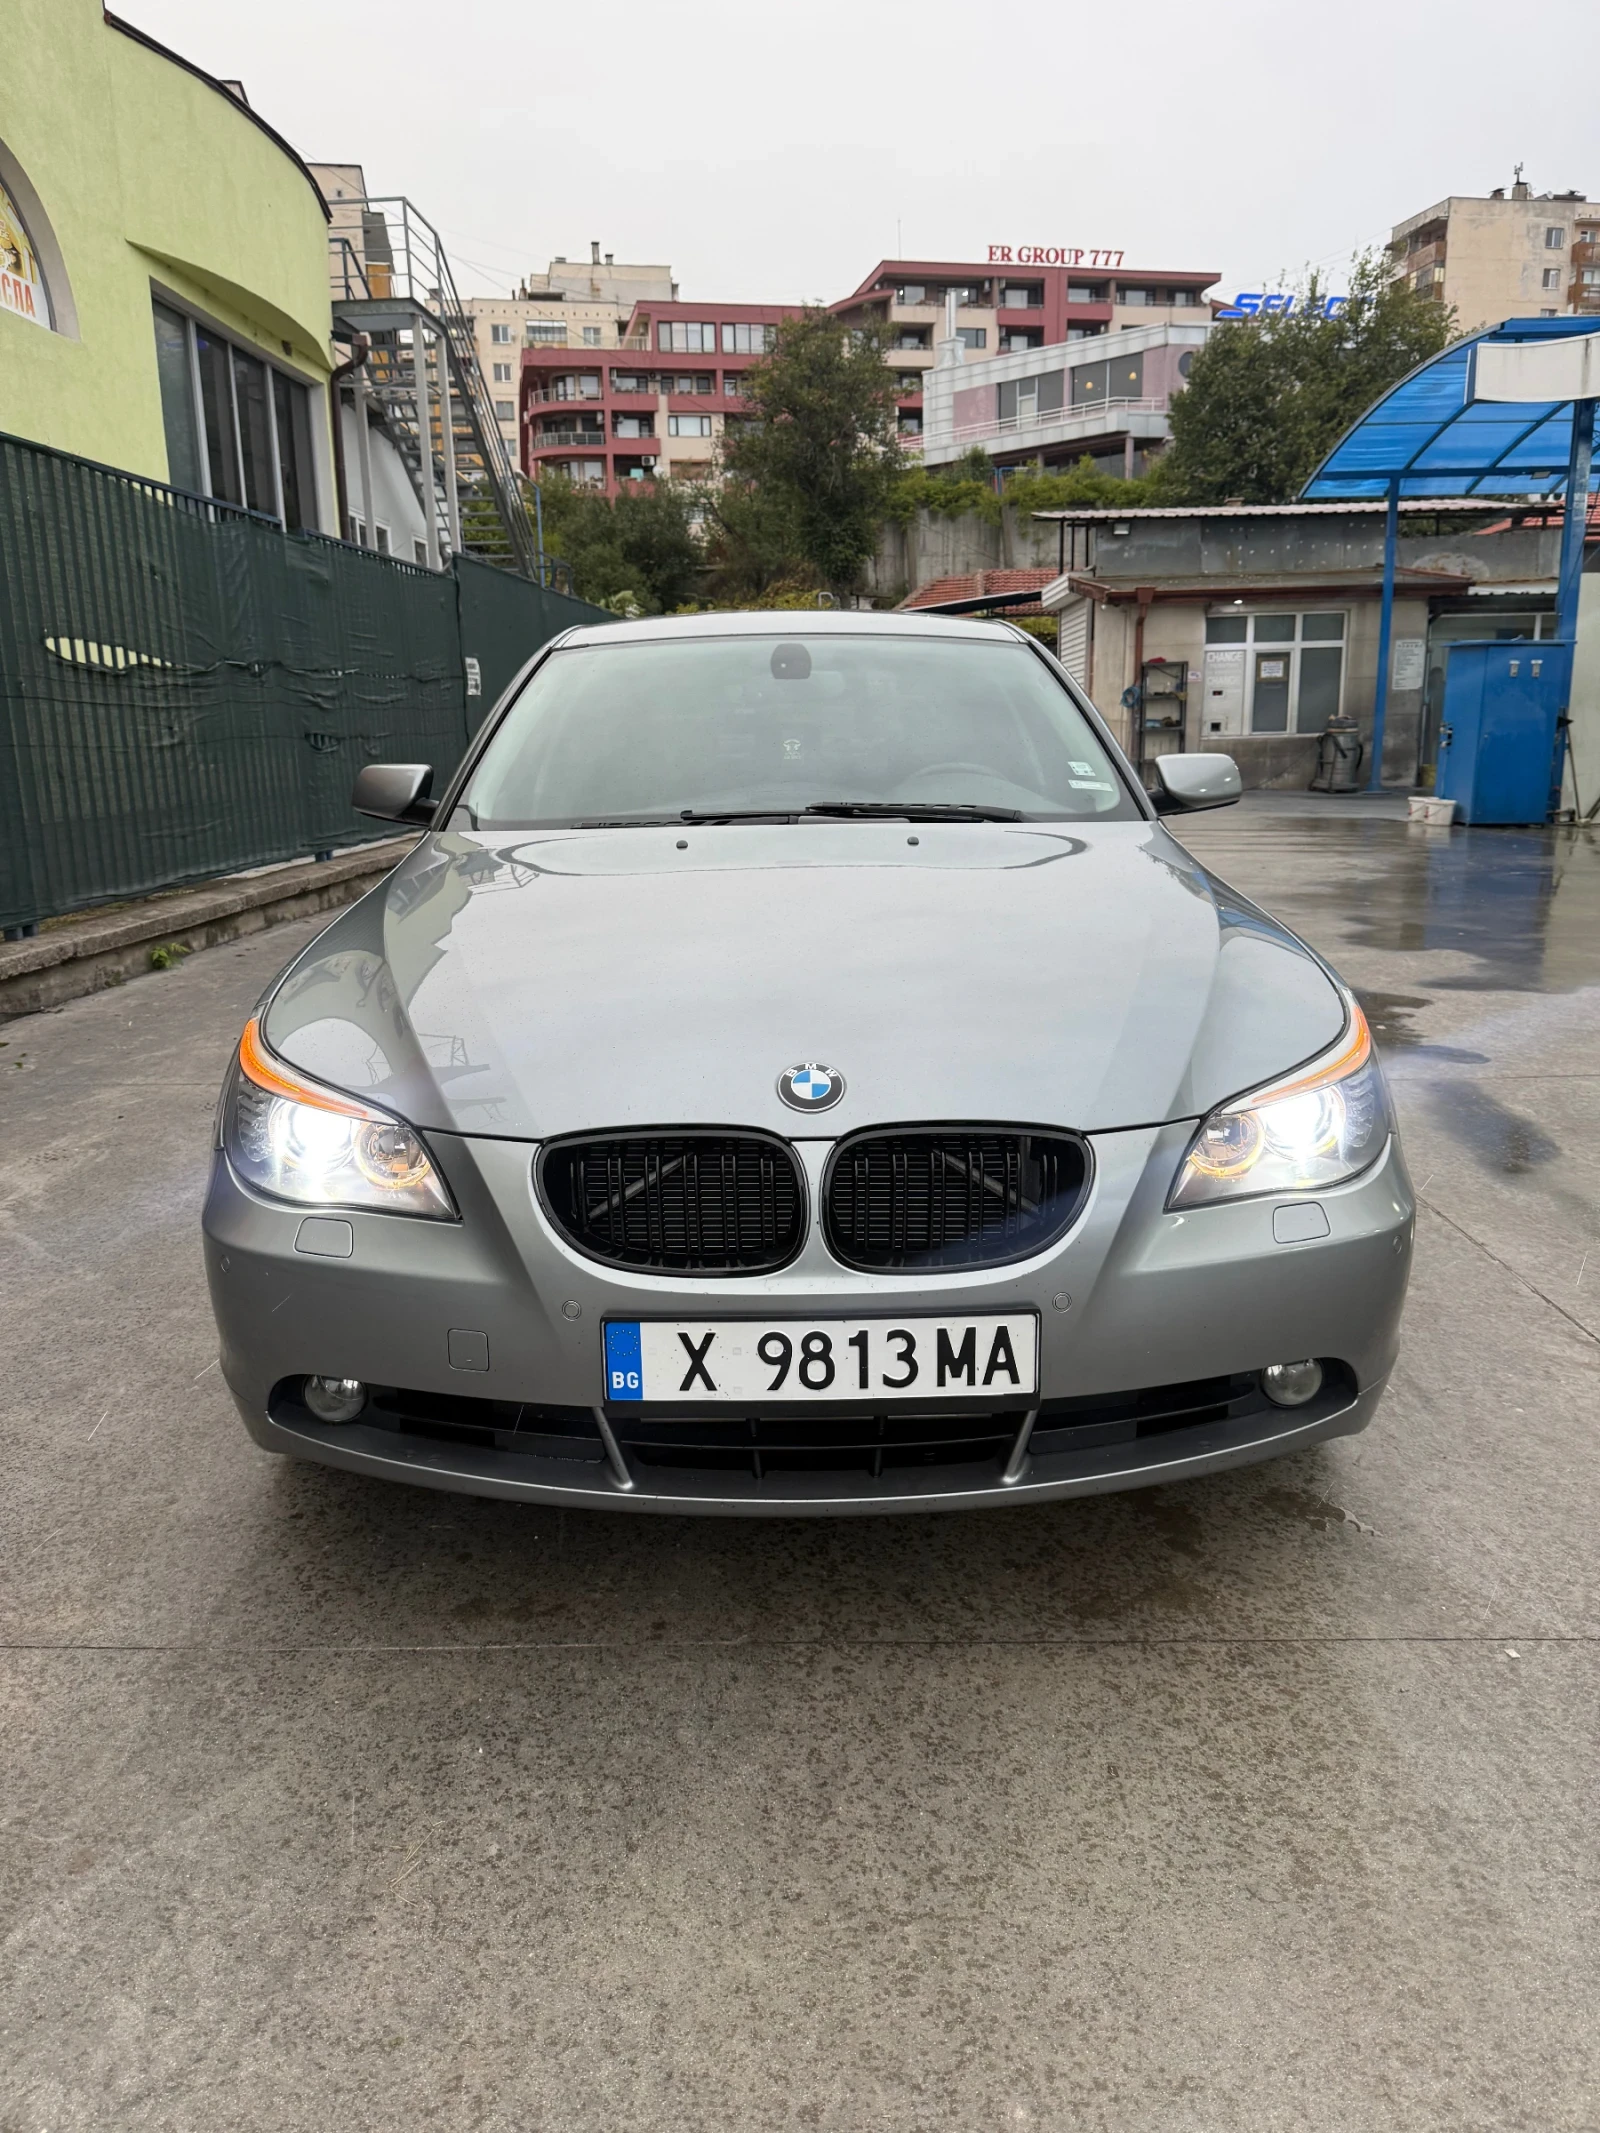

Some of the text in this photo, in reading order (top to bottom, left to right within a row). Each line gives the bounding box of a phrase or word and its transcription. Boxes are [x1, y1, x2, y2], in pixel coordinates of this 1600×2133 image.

[988, 245, 1125, 267] ER GROUP 777
[1215, 293, 1377, 320] SELC
[1206, 651, 1243, 663] CHANGE
[786, 1063, 838, 1077] BMW
[677, 1332, 718, 1392] X
[612, 1371, 639, 1389] BG
